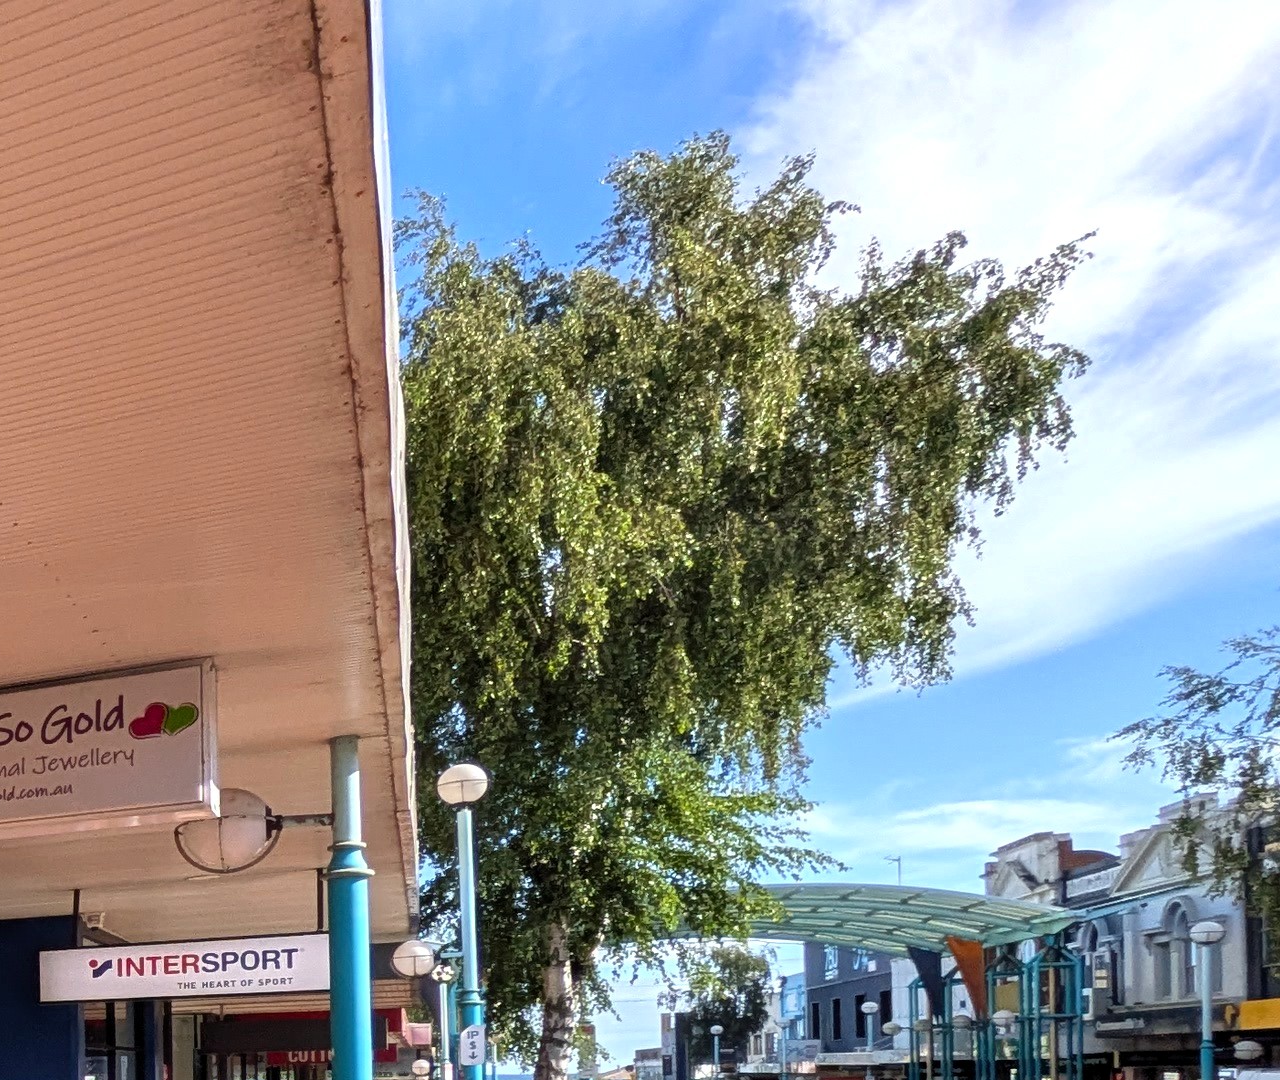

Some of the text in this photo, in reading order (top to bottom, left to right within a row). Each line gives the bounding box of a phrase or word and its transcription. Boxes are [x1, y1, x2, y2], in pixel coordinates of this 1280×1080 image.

[40, 694, 125, 745] Gold
[32, 747, 134, 775] Jewellery
[117, 948, 299, 978] INTERSPORT
[177, 976, 294, 990] THE HEART OF SPORT
[466, 1030, 479, 1040] 1P
